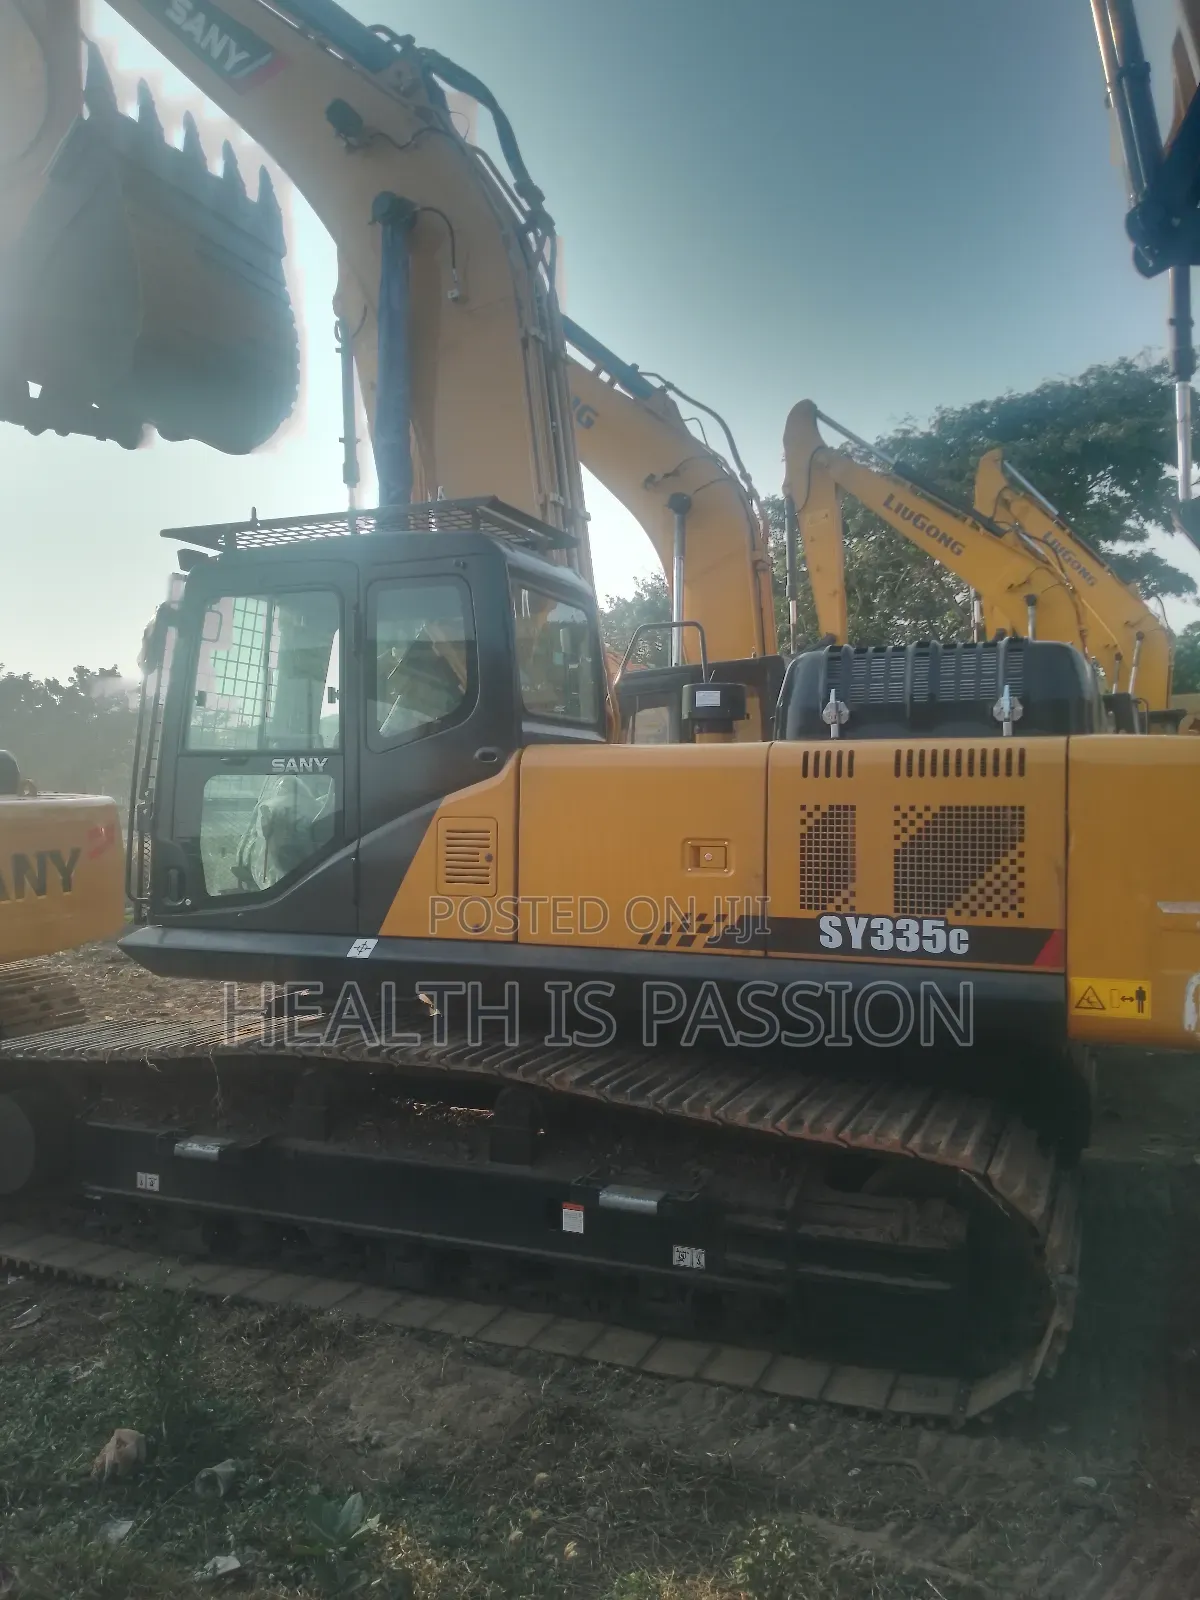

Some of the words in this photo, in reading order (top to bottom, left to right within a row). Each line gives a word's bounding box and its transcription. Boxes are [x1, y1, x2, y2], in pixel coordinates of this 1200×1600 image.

[165, 0, 250, 71] SANY
[883, 493, 966, 556] LIUGONG
[271, 757, 328, 773] SANY
[0, 847, 81, 901] NY
